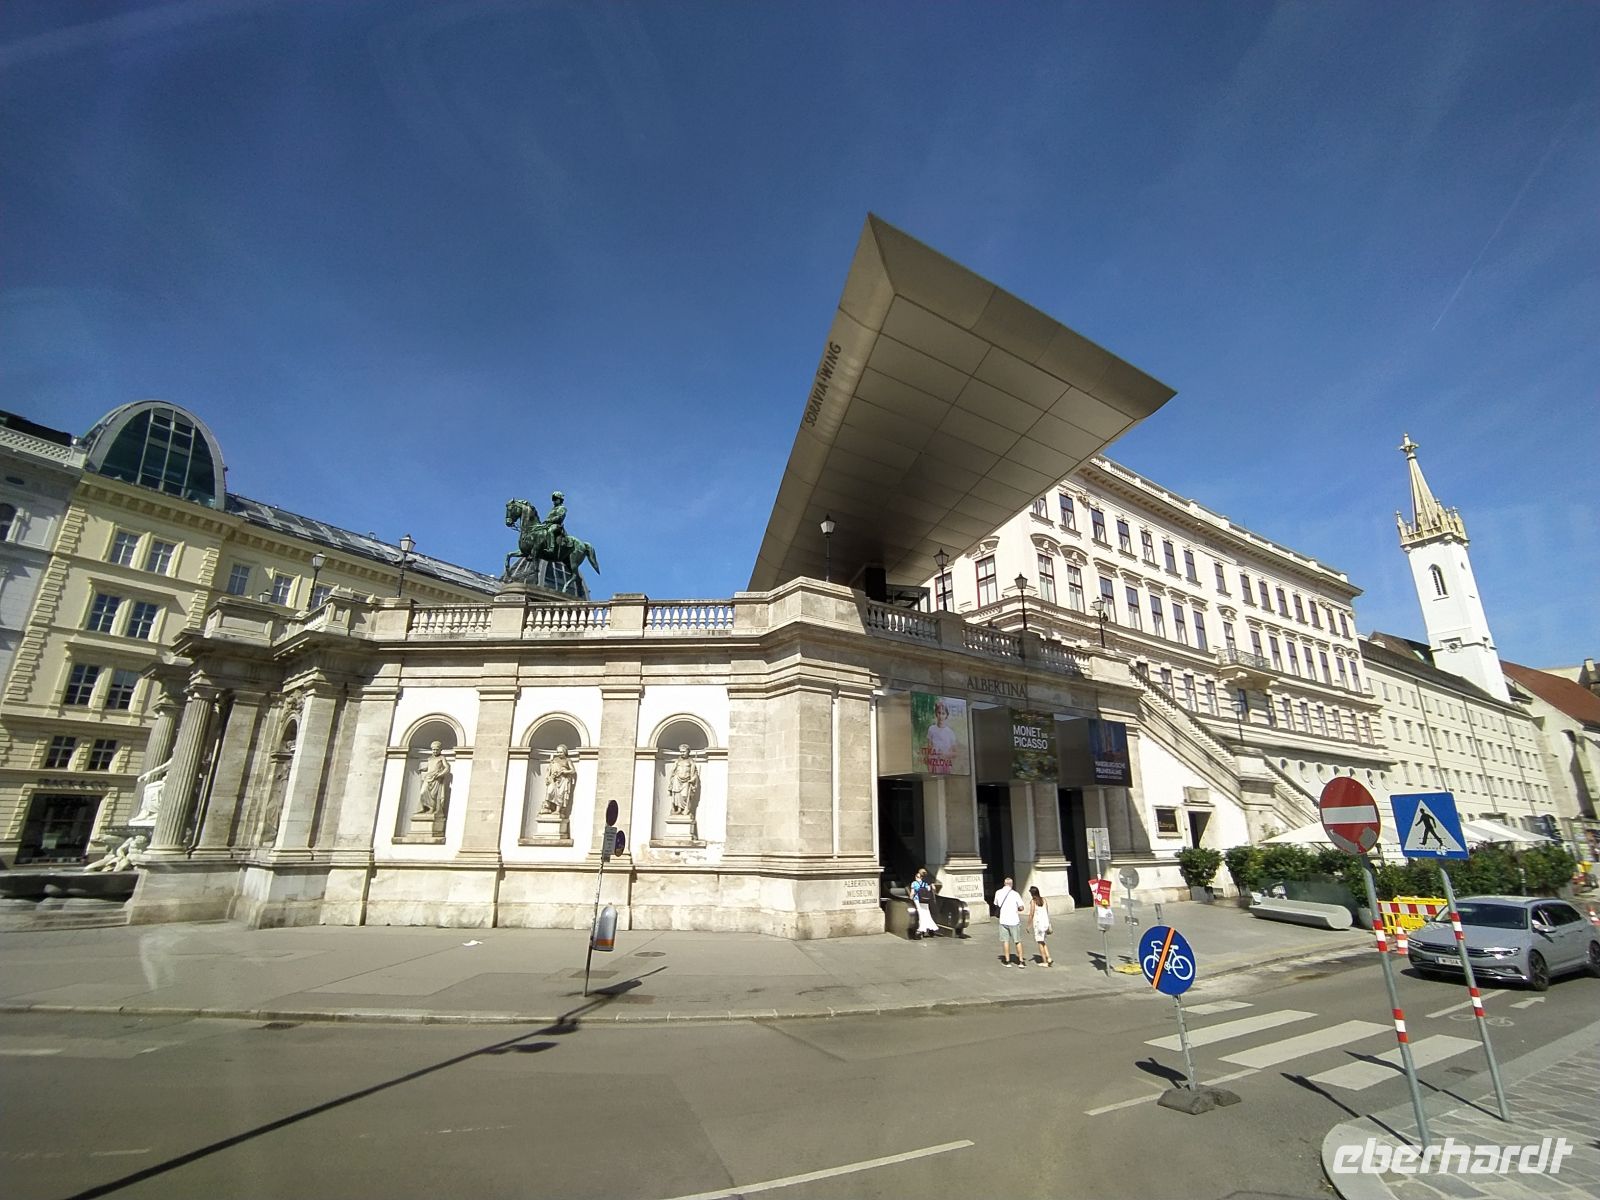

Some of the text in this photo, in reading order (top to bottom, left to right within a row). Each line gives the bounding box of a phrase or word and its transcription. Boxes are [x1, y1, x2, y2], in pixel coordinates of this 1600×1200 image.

[967, 676, 1028, 698] ALBERTINA
[1013, 724, 1042, 738] MONET
[1013, 736, 1048, 750] PICASSO
[843, 879, 877, 888] ALBERTINA
